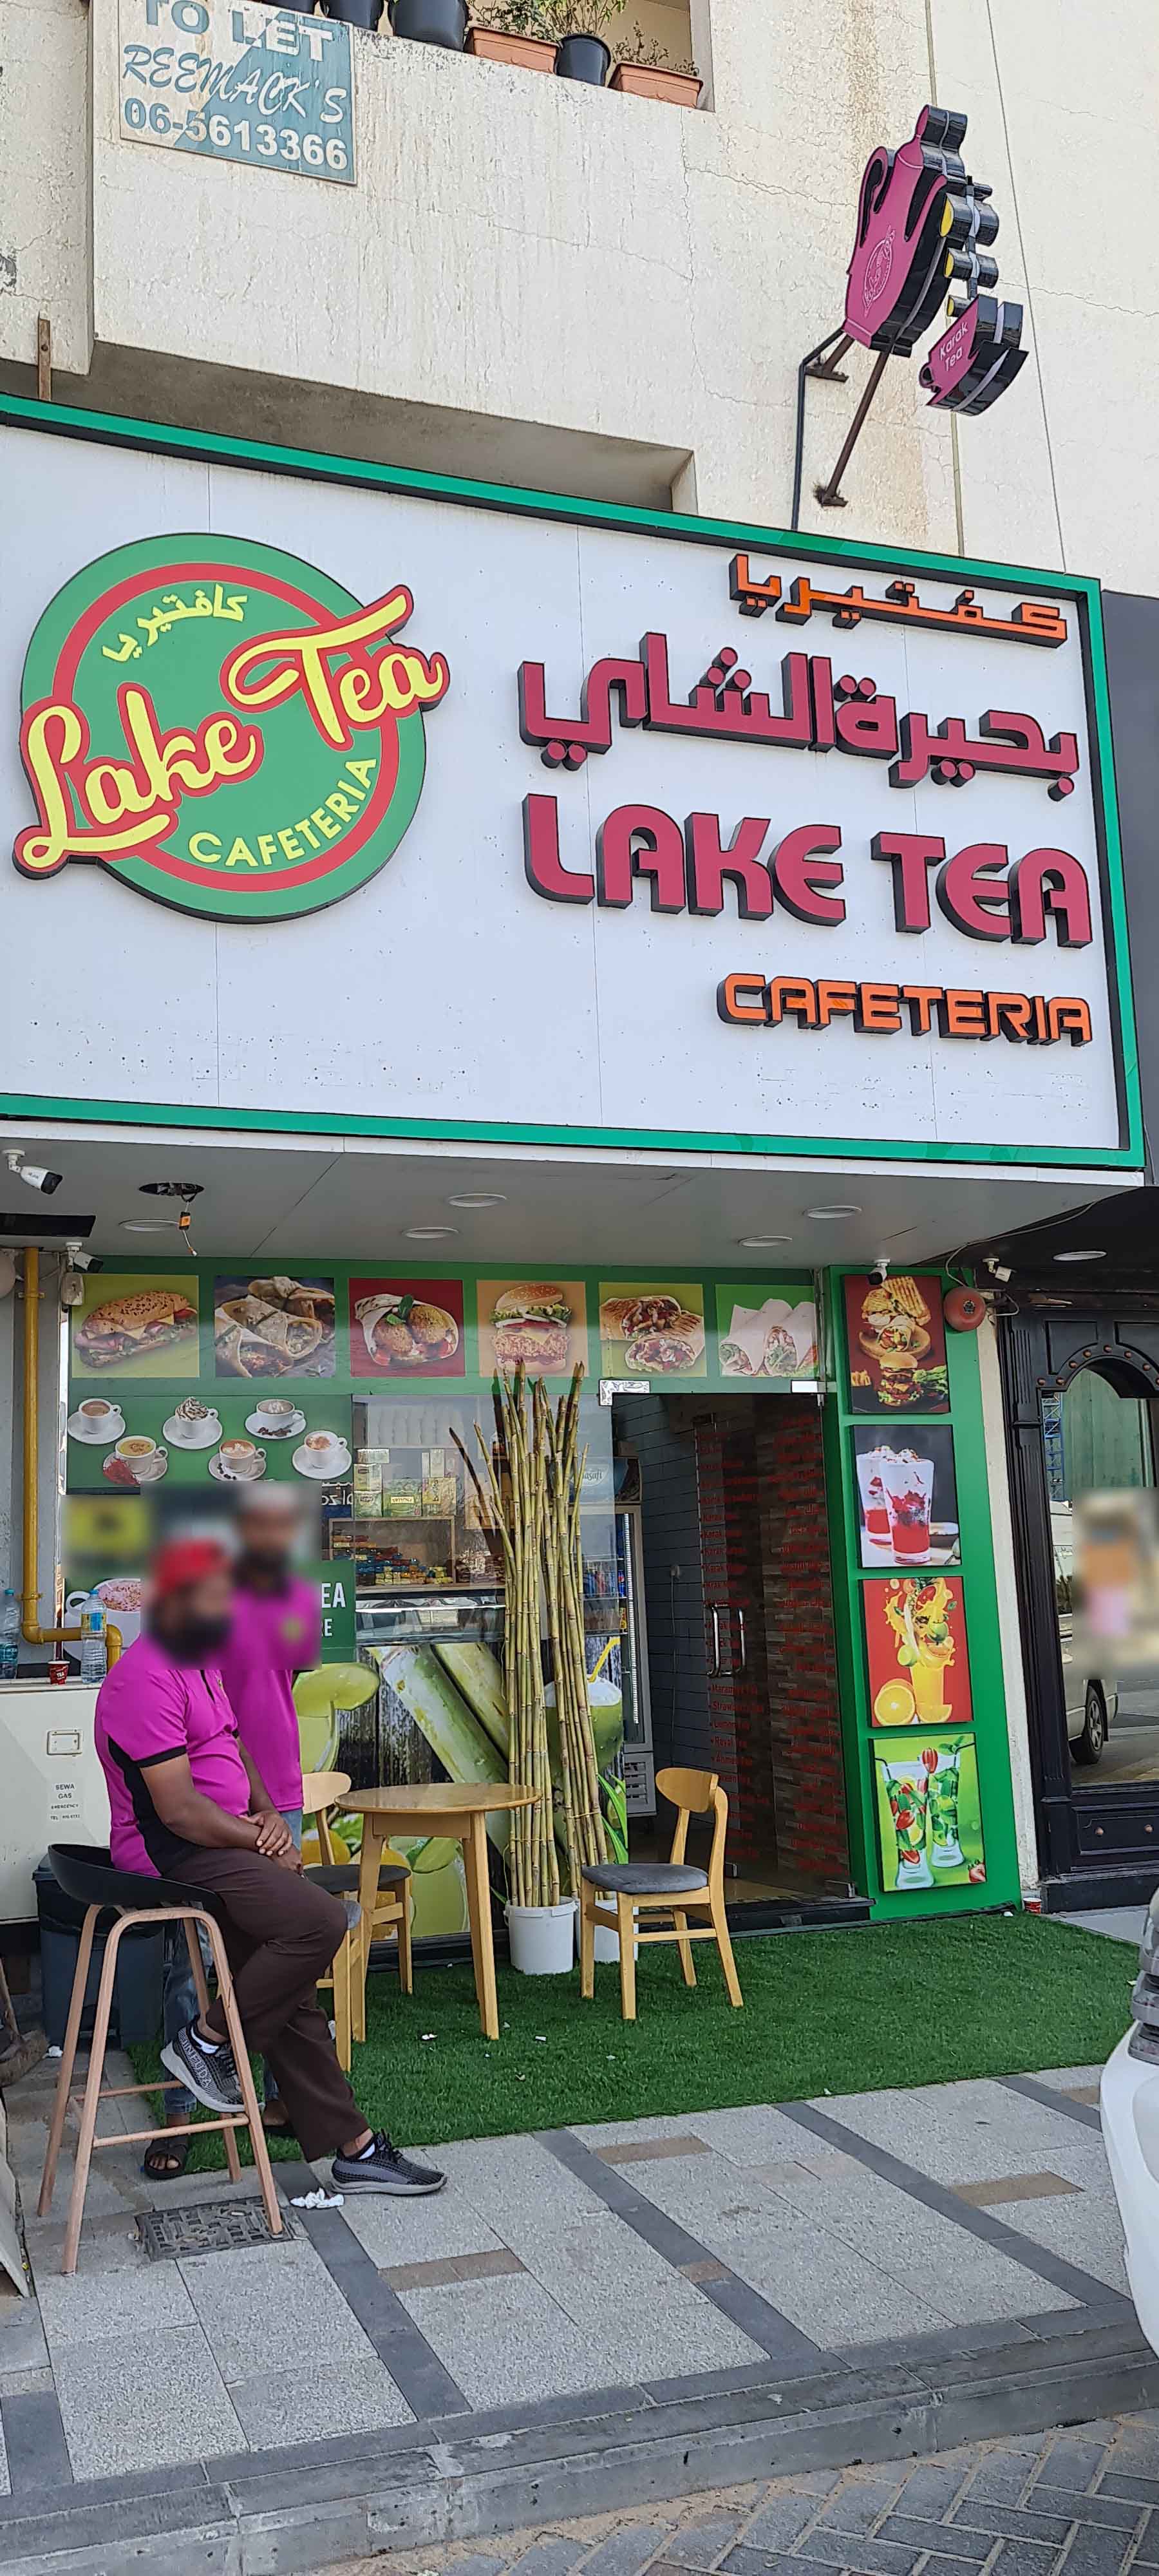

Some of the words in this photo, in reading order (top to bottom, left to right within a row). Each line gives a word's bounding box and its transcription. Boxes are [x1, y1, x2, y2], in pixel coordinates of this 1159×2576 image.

[143, 0, 210, 35] TO
[231, 10, 335, 62] LET
[121, 44, 348, 125] REEMACK'S
[124, 97, 348, 171] 06-5613366
[940, 322, 968, 361] Karak
[945, 346, 963, 372] Tea
[102, 582, 249, 663] كافتيريا
[730, 553, 1069, 648] كفتيريا
[21, 688, 257, 869] Lake
[225, 592, 446, 746] Tea
[187, 757, 378, 868] CAFETERIA
[522, 792, 847, 927] LAKE
[871, 831, 1093, 949] TEA
[717, 972, 1093, 1047] CAFETERIA
